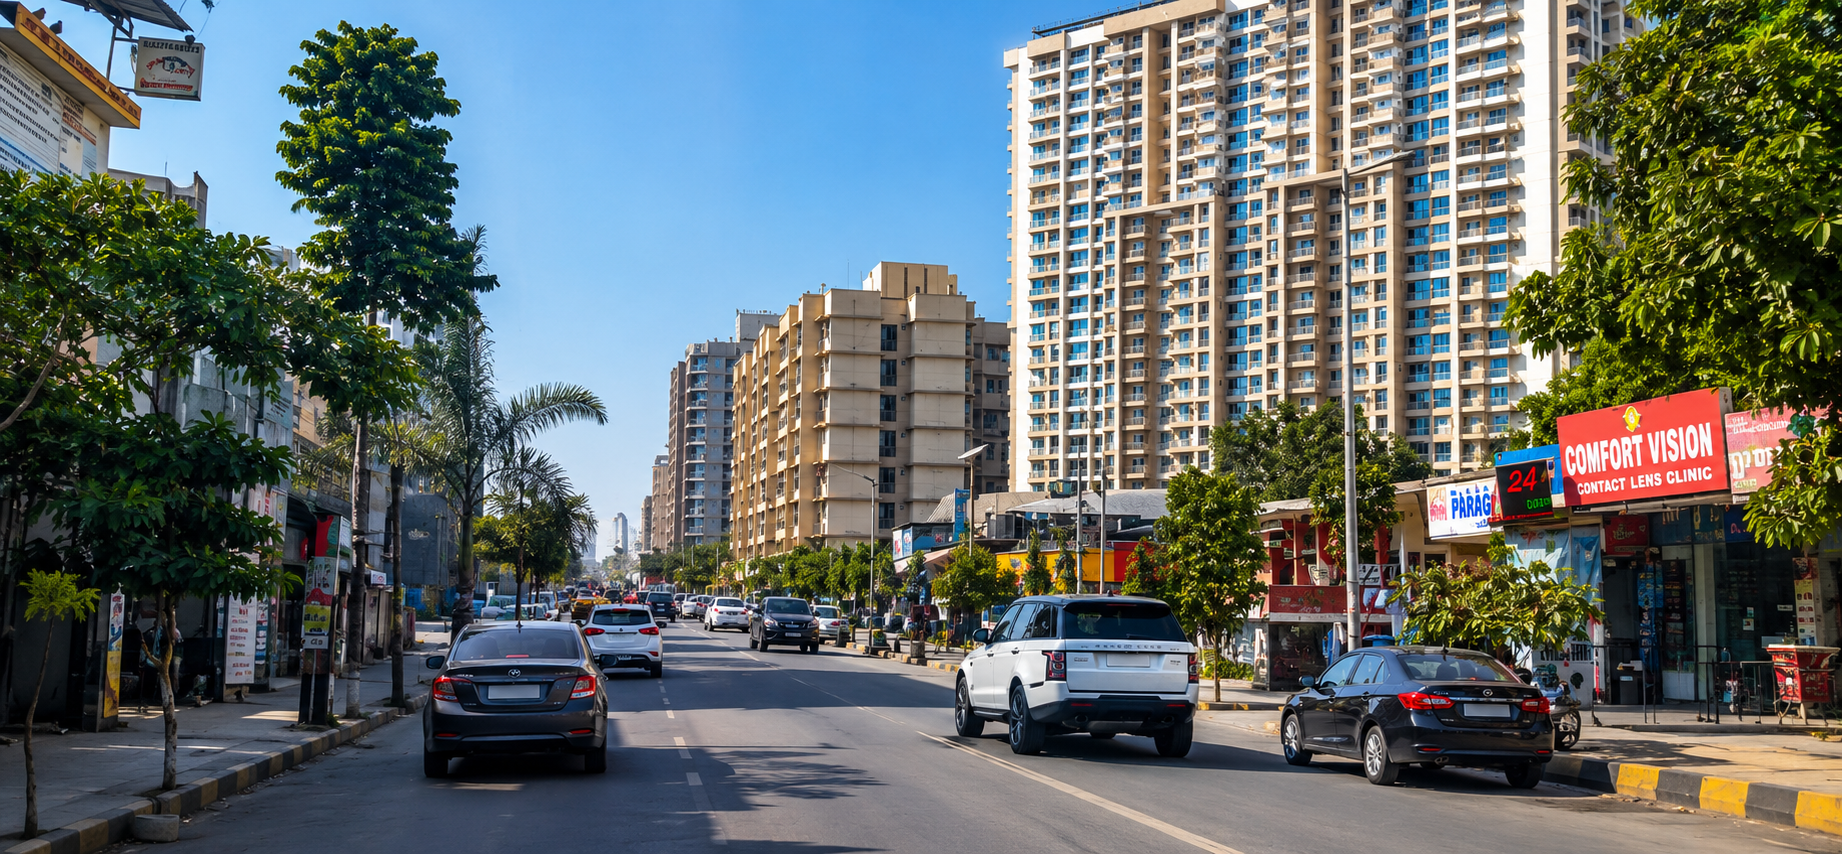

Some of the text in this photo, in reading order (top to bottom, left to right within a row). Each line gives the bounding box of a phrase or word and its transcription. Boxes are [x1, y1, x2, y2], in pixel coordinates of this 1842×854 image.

[1565, 434, 1643, 476] COMFORT
[1647, 422, 1713, 464] VISION
[1507, 466, 1537, 493] 24
[1577, 477, 1626, 495] CONTACT
[1630, 473, 1662, 489] LENS
[1666, 466, 1713, 485] CLINIC
[1451, 493, 1491, 519] PARAG
